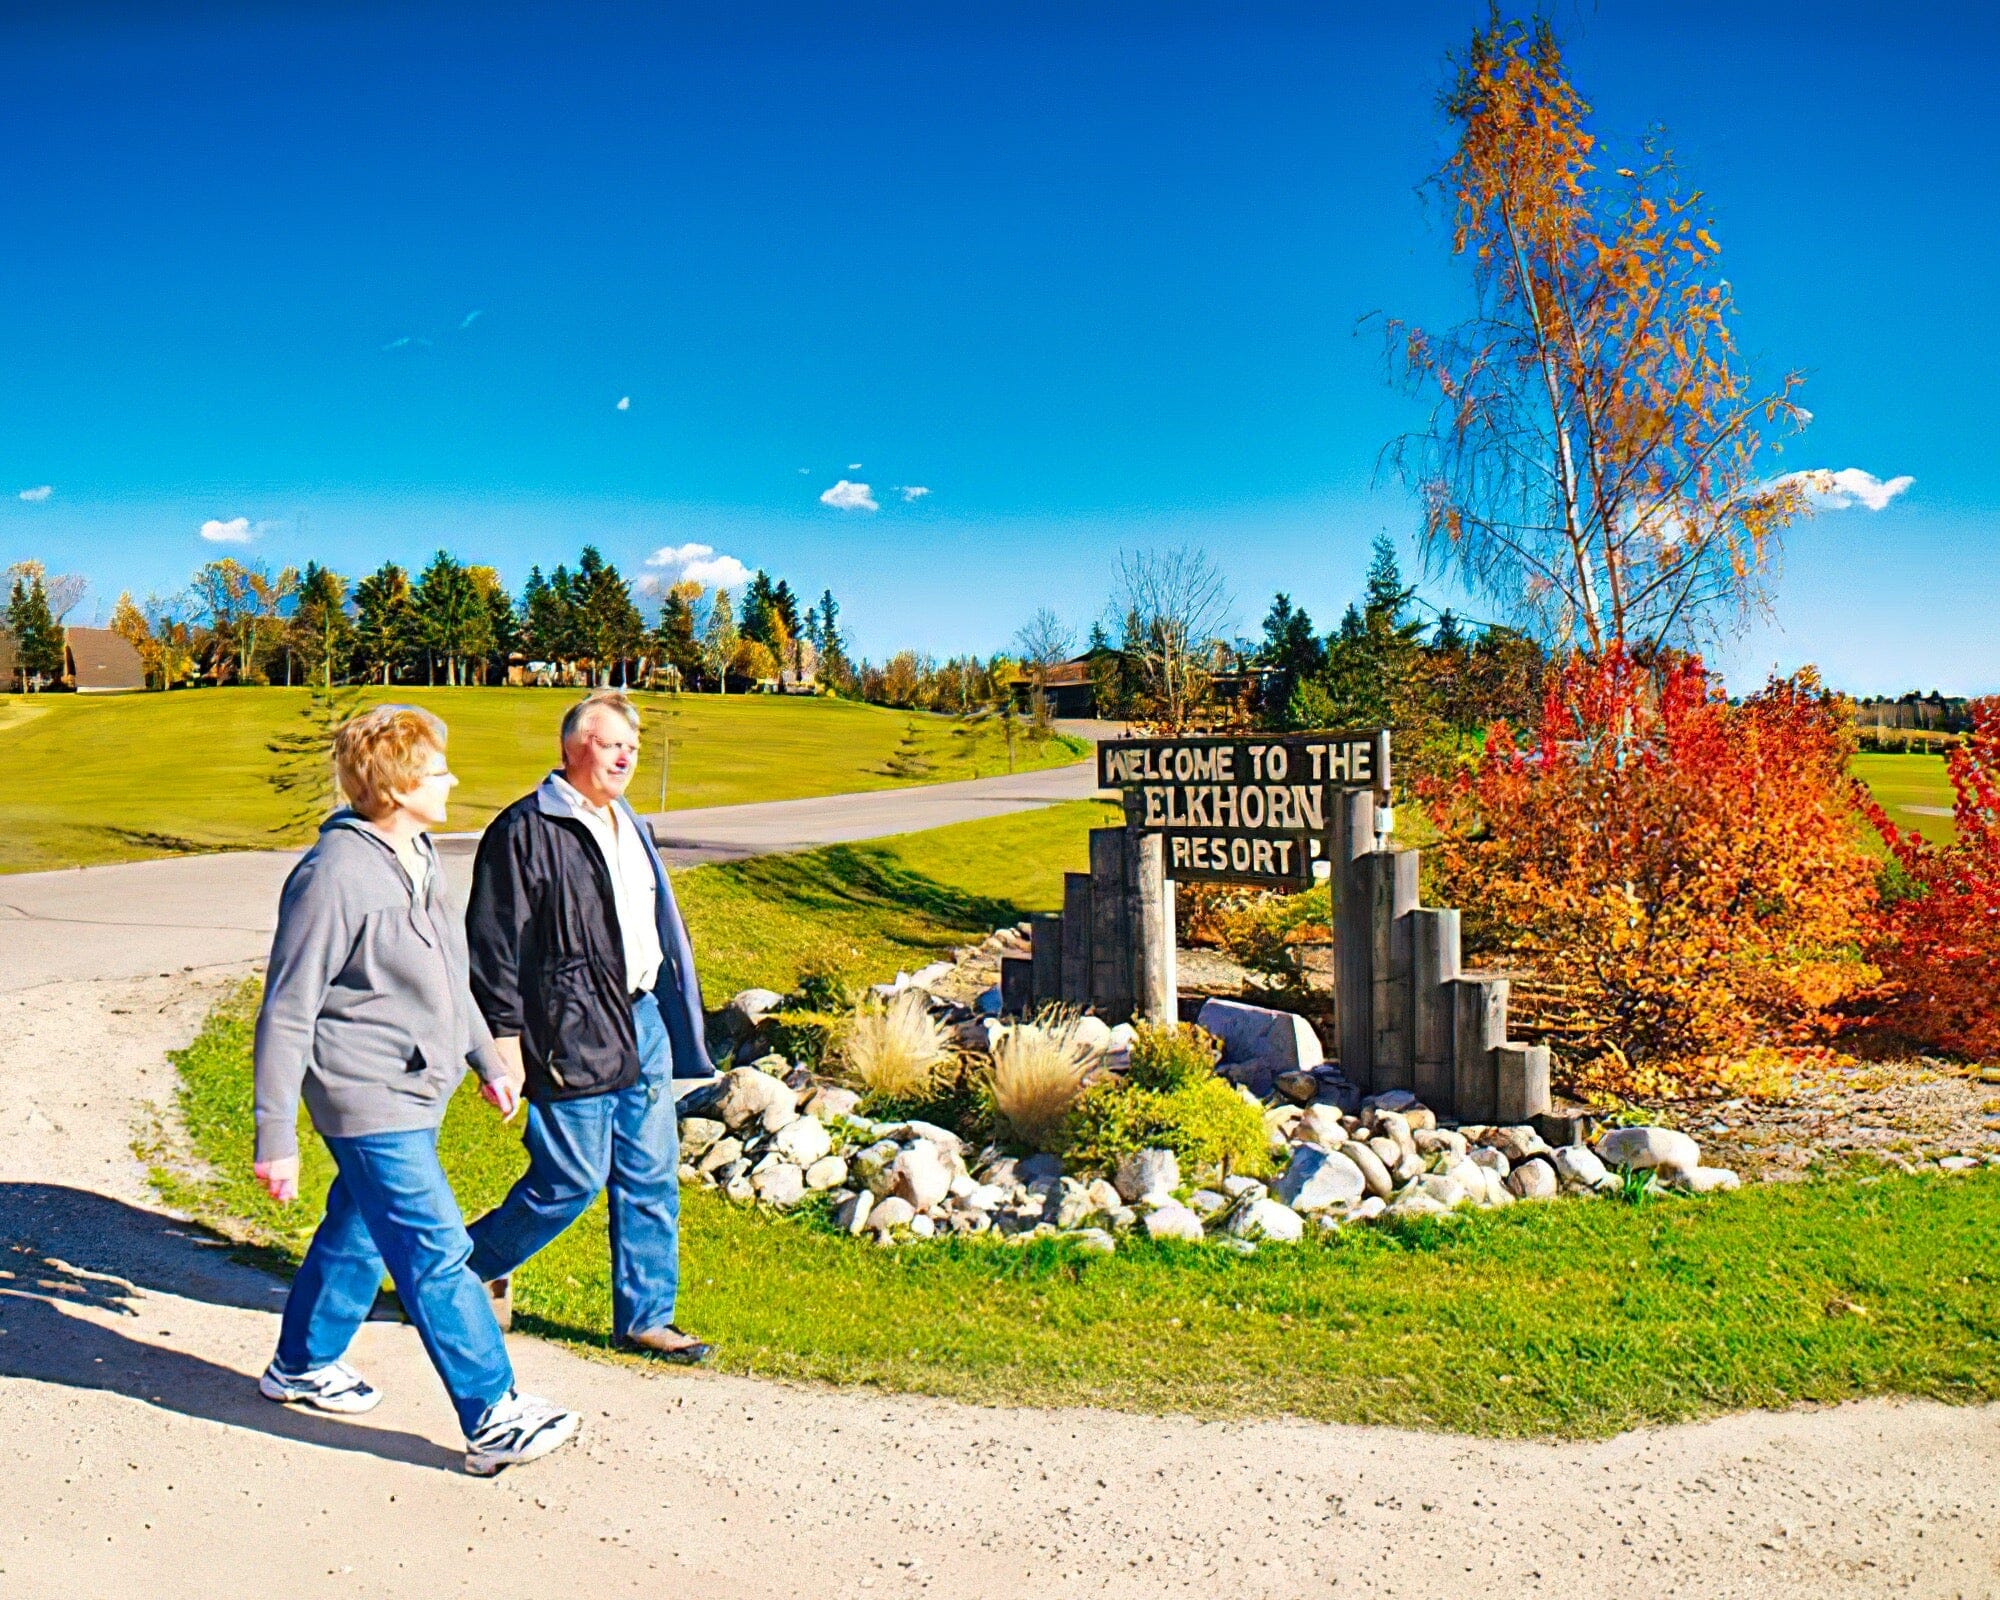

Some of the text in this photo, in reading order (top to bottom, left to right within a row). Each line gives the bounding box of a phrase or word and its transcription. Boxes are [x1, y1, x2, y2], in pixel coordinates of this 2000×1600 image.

[1105, 741, 1372, 783] WELCOME TO THE
[1144, 785, 1324, 830] ELKHORN
[1171, 836, 1294, 875] RESORT
